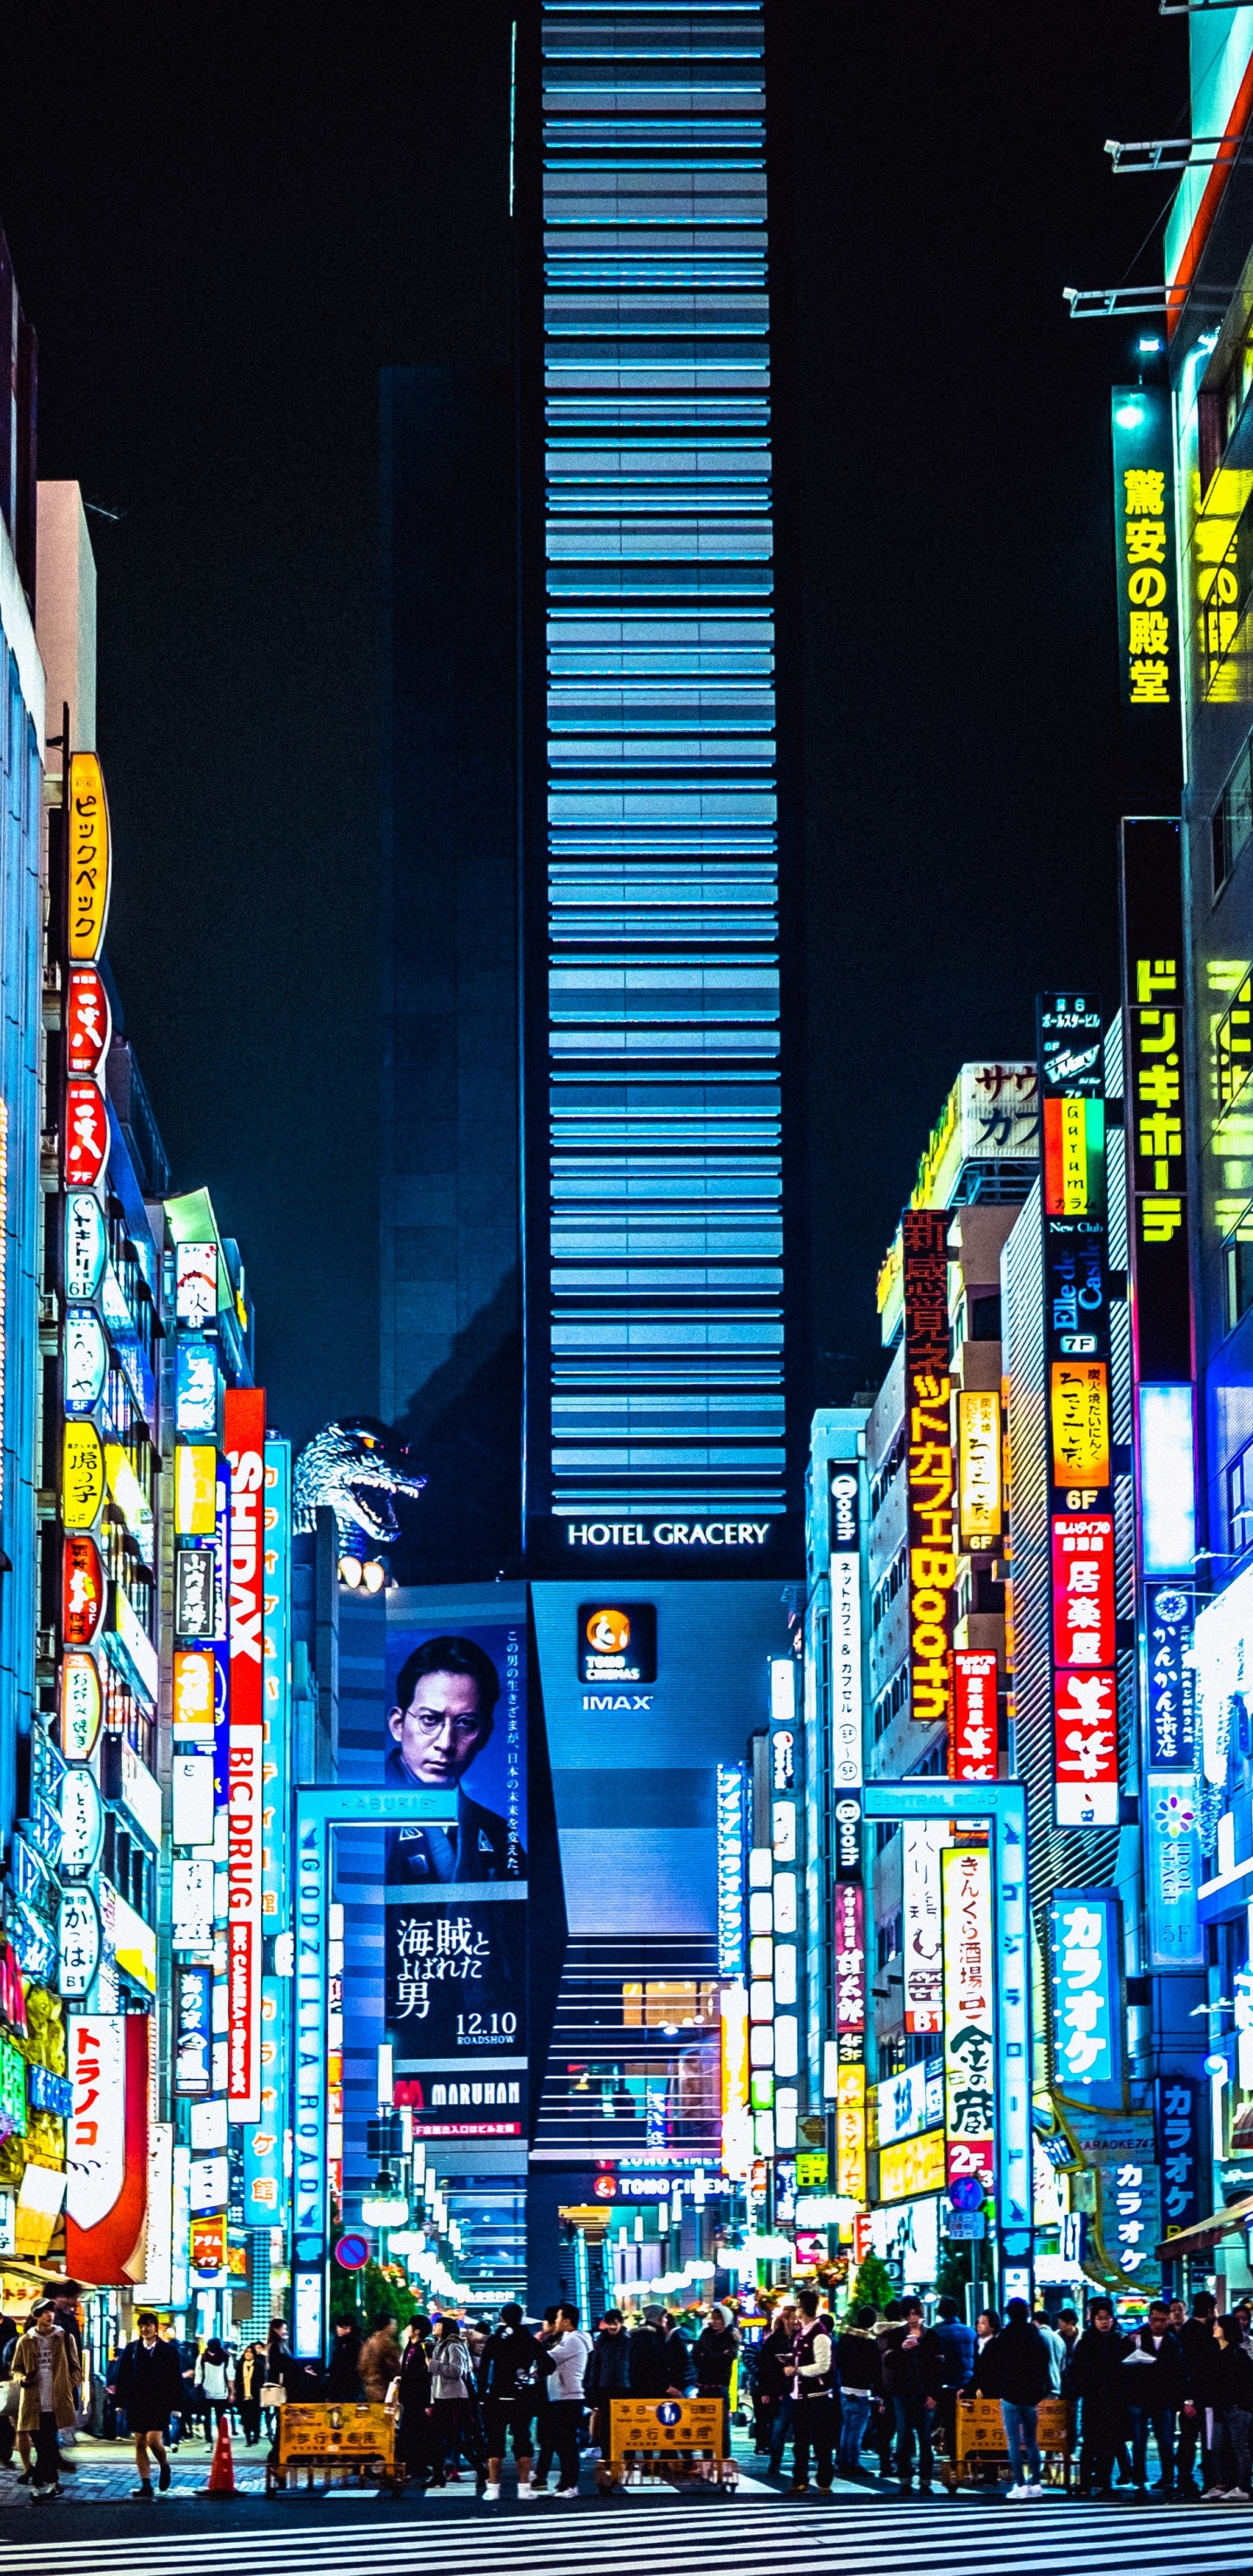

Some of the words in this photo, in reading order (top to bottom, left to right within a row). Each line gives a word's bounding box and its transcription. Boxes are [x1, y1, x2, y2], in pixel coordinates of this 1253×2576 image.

[1124, 469, 1169, 702] 驚安の殿堂
[71, 1171, 92, 1182] 7F
[1049, 1223, 1075, 1232] New
[1077, 1222, 1103, 1233] Club
[70, 1282, 94, 1296] 6F
[1053, 1284, 1078, 1330] Elle
[1066, 1338, 1092, 1350] 7F
[72, 1400, 88, 1411] 5F
[70, 1452, 97, 1504] 虎の子
[1066, 1489, 1099, 1510] 6F
[568, 1525, 650, 1545] HOTEL
[654, 1524, 770, 1545] GRACERY
[969, 1536, 993, 1550] 6F
[231, 1451, 263, 1664] SHIDAX
[841, 1563, 852, 1636] ネットカフェ
[583, 1696, 651, 1710] IMAX
[506, 1631, 519, 1875] この男の生きざまが、日本の未来を変えた。
[229, 1748, 253, 1802] BIC
[66, 1865, 85, 1876] 1F
[229, 1815, 252, 1908] DRUG
[960, 1856, 984, 1989] きんくら酒場
[1163, 1924, 1190, 1942] 5F
[397, 1917, 490, 1957] 海賊と
[301, 1858, 320, 2068] GODZILLA
[397, 1957, 482, 1981] よばれた
[396, 1982, 431, 2019] 男
[1062, 1907, 1106, 2073] カラオケ
[457, 2011, 518, 2036] 12.10
[914, 2011, 943, 2031] B1
[458, 2035, 516, 2045] ROADSHOW
[839, 2034, 863, 2047] 4F
[839, 2048, 862, 2062] 3F
[75, 2029, 101, 2146] トラノコ
[950, 2024, 995, 2135] 金の蔵
[432, 2083, 520, 2106] MARUHAN
[300, 2094, 319, 2193] ROAD
[1164, 2085, 1195, 2217] カラオケ
[950, 2144, 985, 2173] 2F
[619, 2178, 670, 2195] TOHO
[1116, 2163, 1147, 2273] カラオケ
